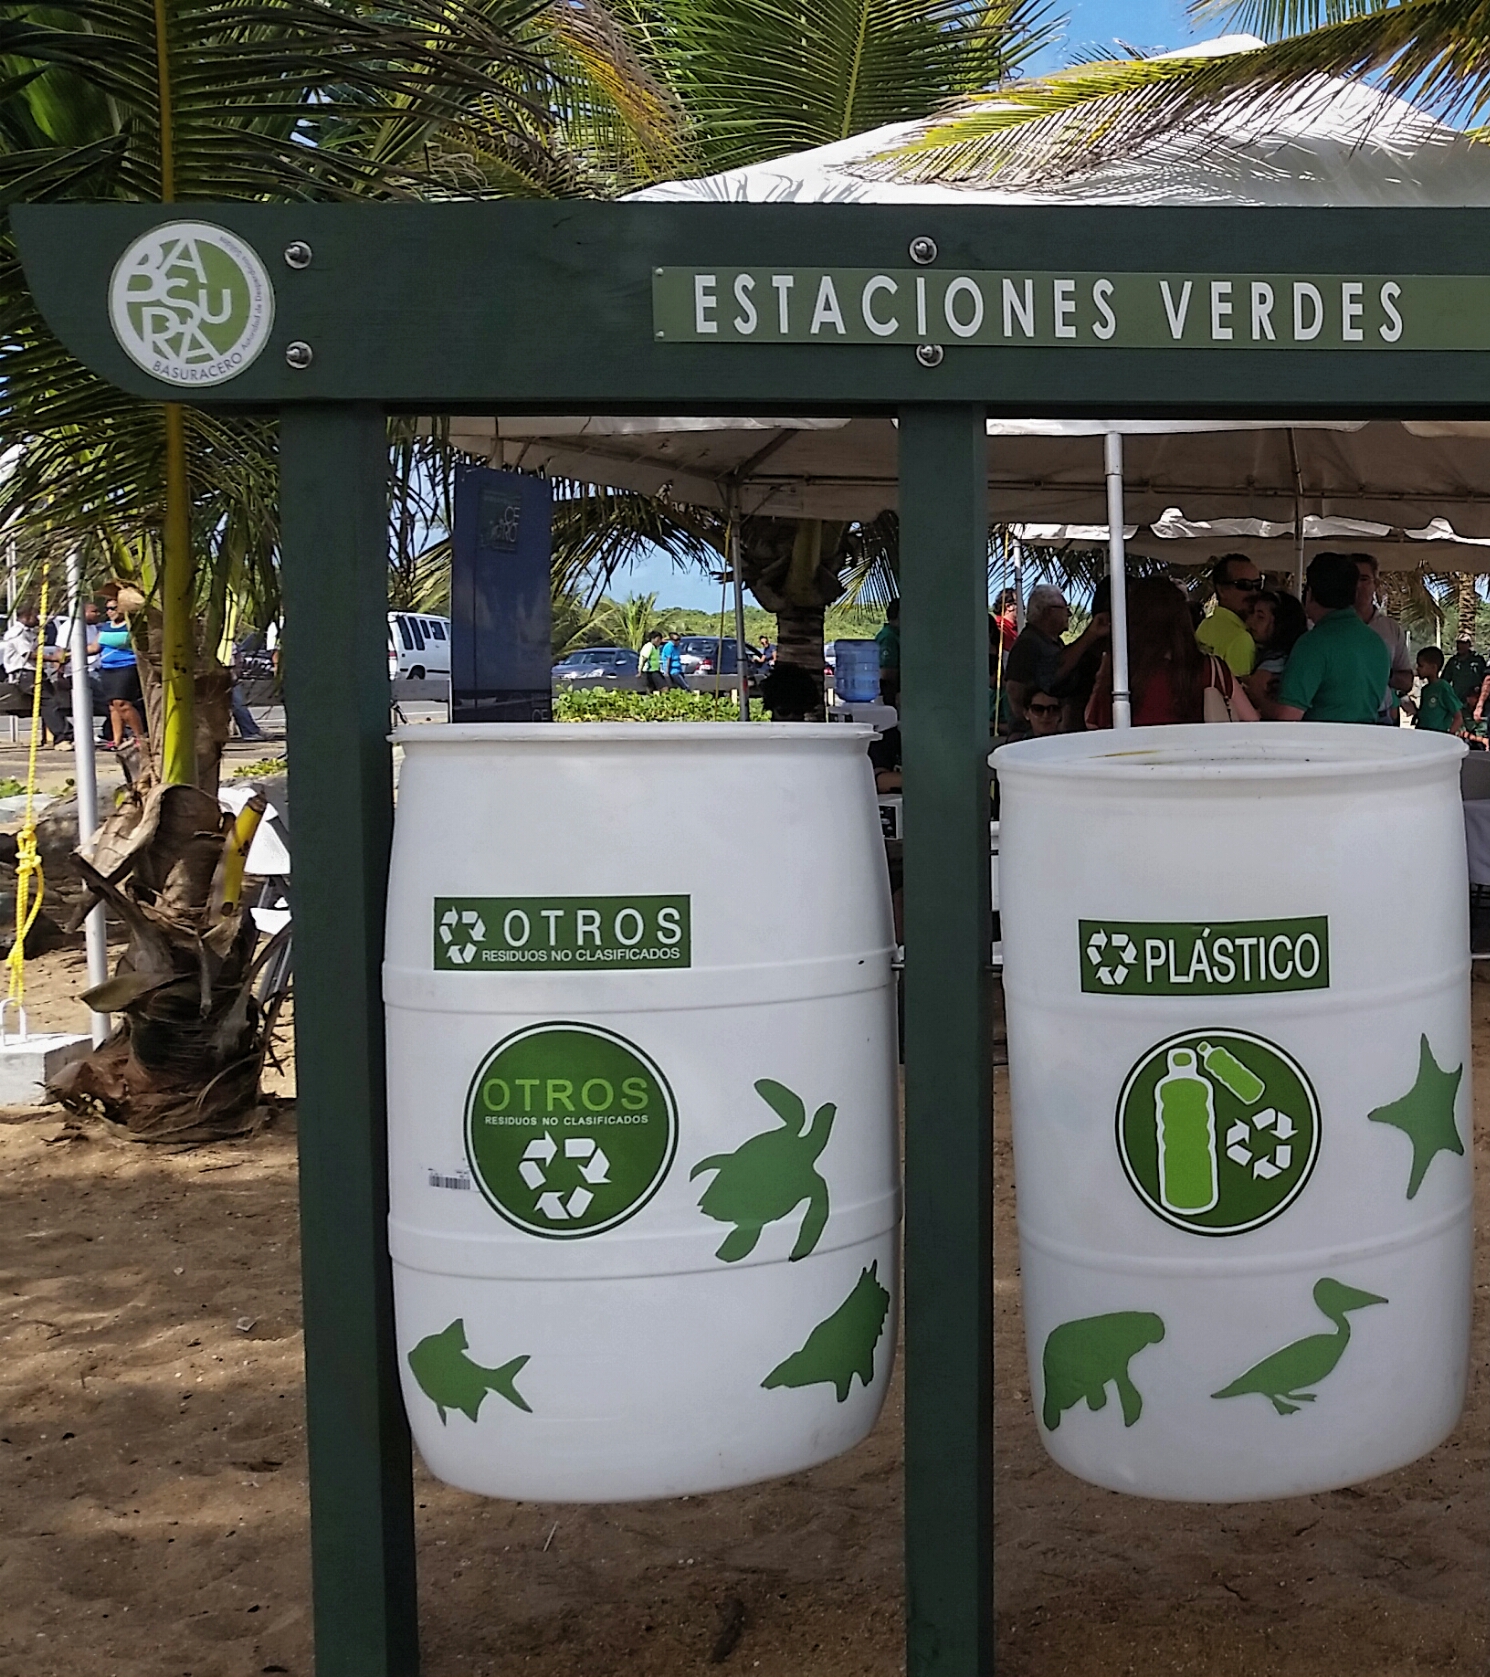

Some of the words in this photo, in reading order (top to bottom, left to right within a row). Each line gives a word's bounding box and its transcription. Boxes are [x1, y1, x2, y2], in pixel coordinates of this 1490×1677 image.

[694, 273, 1117, 340] ESTACIONES
[1159, 280, 1404, 343] VERDES
[241, 315, 262, 351] Autoridad
[152, 352, 243, 381] BASURACERO
[503, 906, 683, 948] OTROS
[482, 949, 548, 962] RESIDUOS
[551, 949, 573, 962] NO
[575, 947, 682, 961] CLASIFICADOS
[1144, 927, 1321, 984] PLÁSTICO
[482, 1077, 650, 1112] OTROS
[484, 1116, 538, 1126] RESIDUOS
[542, 1116, 559, 1126] NO
[563, 1114, 650, 1126] CLASIFICADOS
